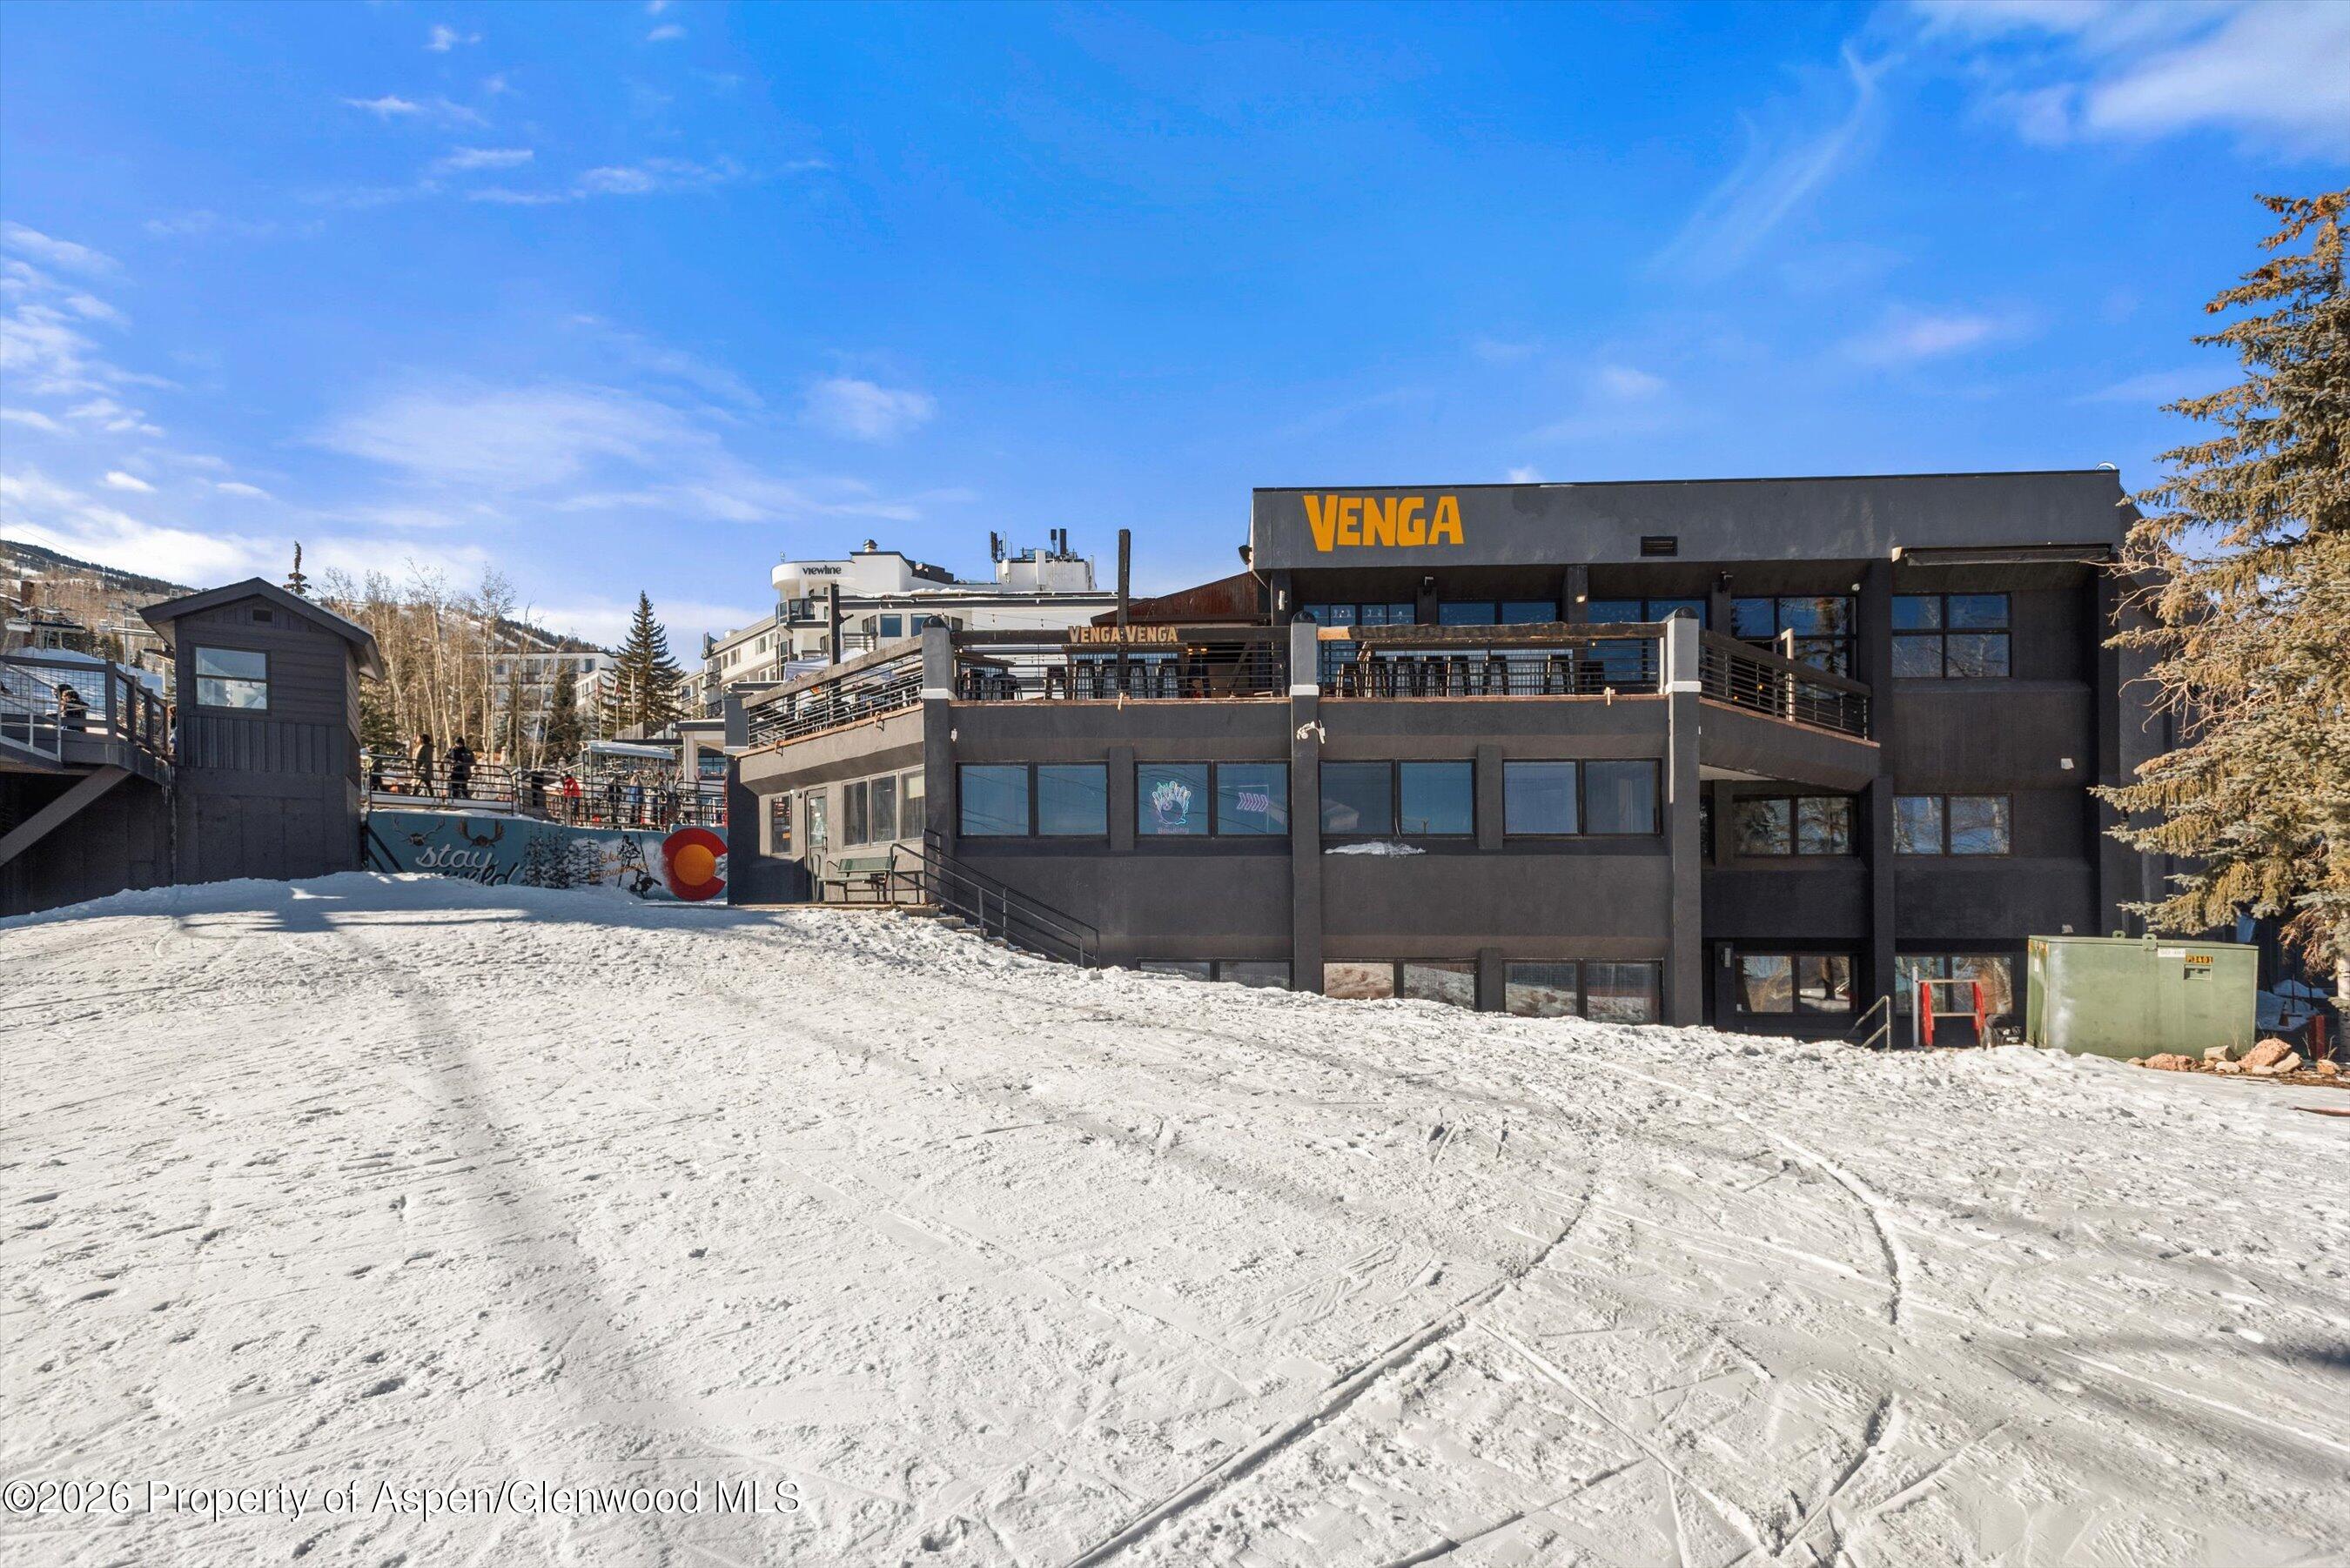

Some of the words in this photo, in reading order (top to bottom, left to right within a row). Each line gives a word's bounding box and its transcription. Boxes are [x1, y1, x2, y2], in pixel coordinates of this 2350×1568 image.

[1303, 494, 1464, 552] VENGA
[802, 565, 842, 574] viewline
[1068, 626, 1121, 643] VENGA
[1125, 625, 1178, 643] VENGA
[415, 843, 500, 881] stay
